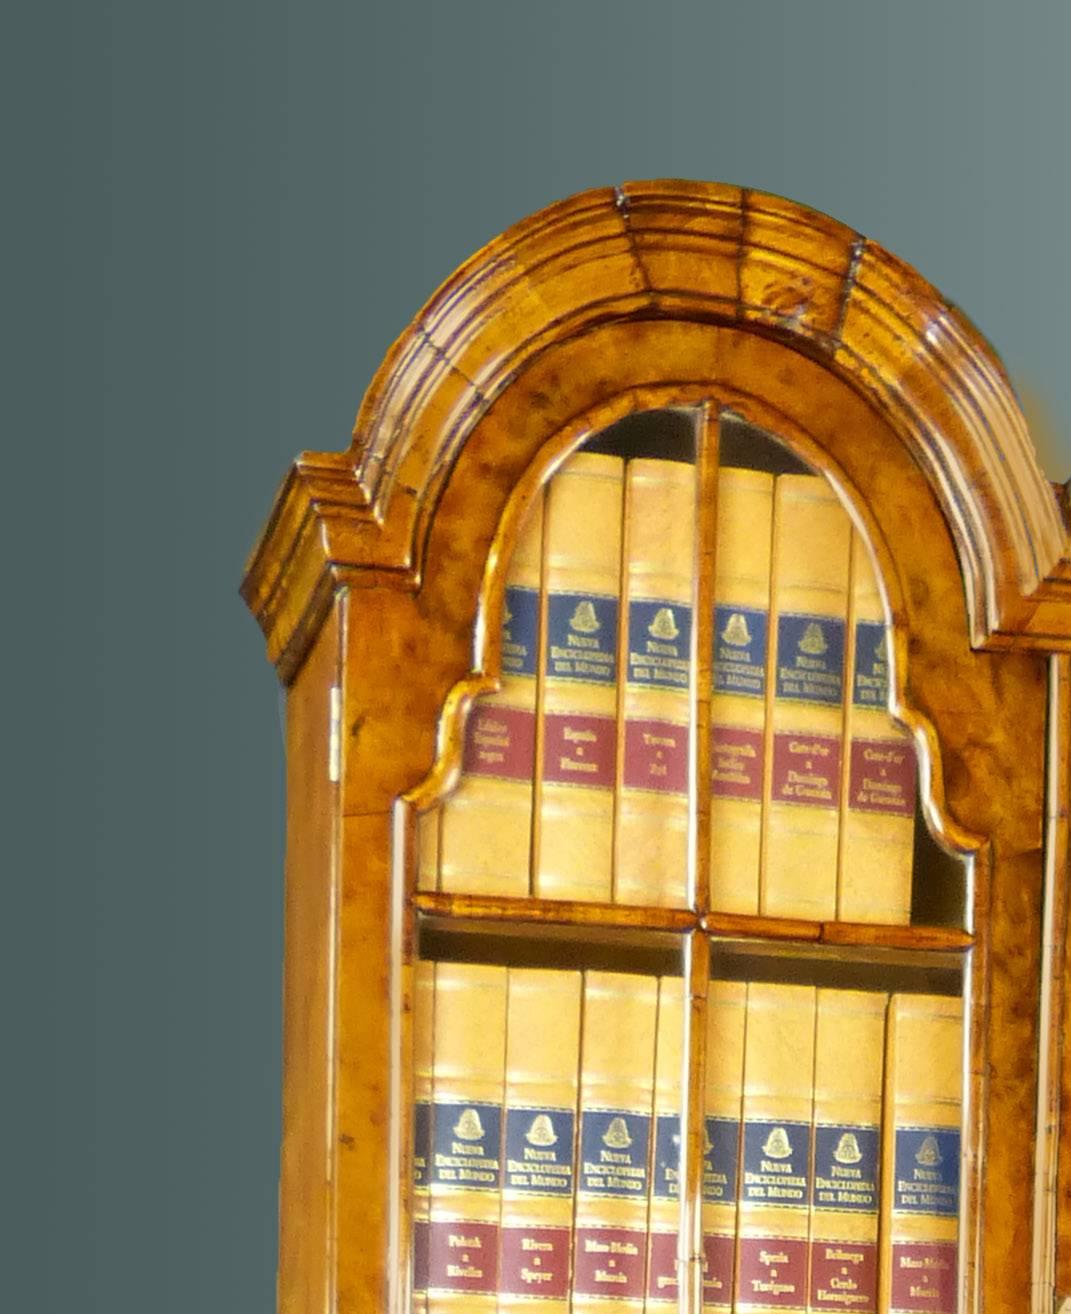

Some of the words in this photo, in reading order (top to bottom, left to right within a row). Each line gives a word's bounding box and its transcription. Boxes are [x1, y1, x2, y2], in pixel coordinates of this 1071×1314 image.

[452, 1143, 484, 1156] NUEVA
[524, 1149, 556, 1161] NUEVA
[435, 1155, 499, 1170] ENCICLOPEDIA
[601, 1151, 631, 1164] NUEVA
[507, 1161, 572, 1176] ENCICLOPEDIA
[584, 1163, 645, 1178] ENCICLOPEDIA
[760, 1161, 792, 1174] NUEVA
[831, 1167, 862, 1180] NUEVA
[459, 1170, 495, 1182] MUNDO
[531, 1176, 567, 1188] MUNDO
[745, 1174, 806, 1187] ENCICLOPEDIA
[607, 1178, 642, 1190] MUNDO
[815, 1178, 874, 1192] ENCICLOPEDIA
[767, 1187, 803, 1199] MUNDO
[837, 1191, 872, 1204] MUNDO
